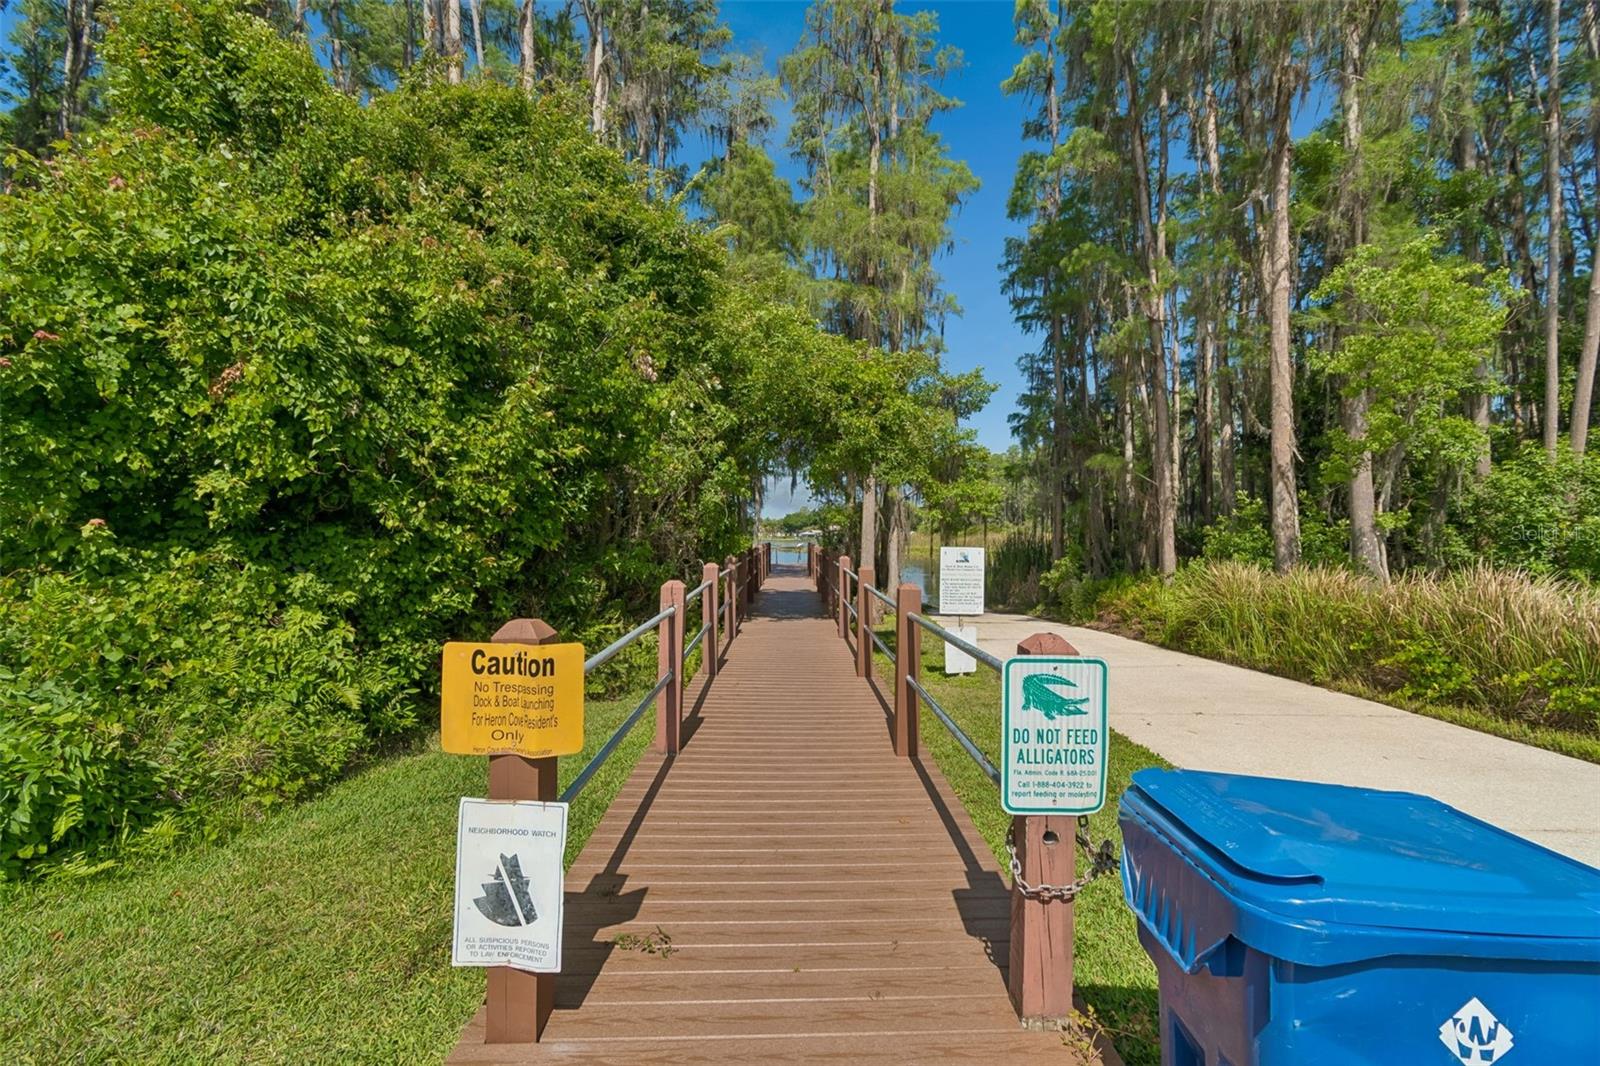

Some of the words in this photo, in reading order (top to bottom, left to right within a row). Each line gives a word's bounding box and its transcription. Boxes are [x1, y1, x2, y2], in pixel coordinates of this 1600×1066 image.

[471, 649, 555, 677] Caution
[474, 681, 489, 693] No
[493, 681, 554, 697] Trespassing
[473, 695, 492, 707] Dock
[494, 695, 500, 707] &
[502, 695, 519, 707] Boat
[521, 697, 554, 712] Launching
[472, 712, 484, 726] For
[485, 713, 507, 727] Heron
[508, 712, 523, 727] Cove
[523, 714, 559, 729] Resident's
[492, 729, 524, 743] Only
[1013, 728, 1030, 744] DO
[1037, 728, 1061, 744] NOT
[1067, 729, 1098, 745] FEED
[1017, 748, 1095, 765] ALLIGATORS
[468, 826, 528, 836] NEIGHBORHOOD
[531, 830, 556, 838] WATCH
[479, 937, 520, 945] SUSPICIOUS
[521, 939, 550, 949] PERSONS
[497, 951, 543, 963] ENFORCEMENT
[515, 947, 547, 957] REPORTED
